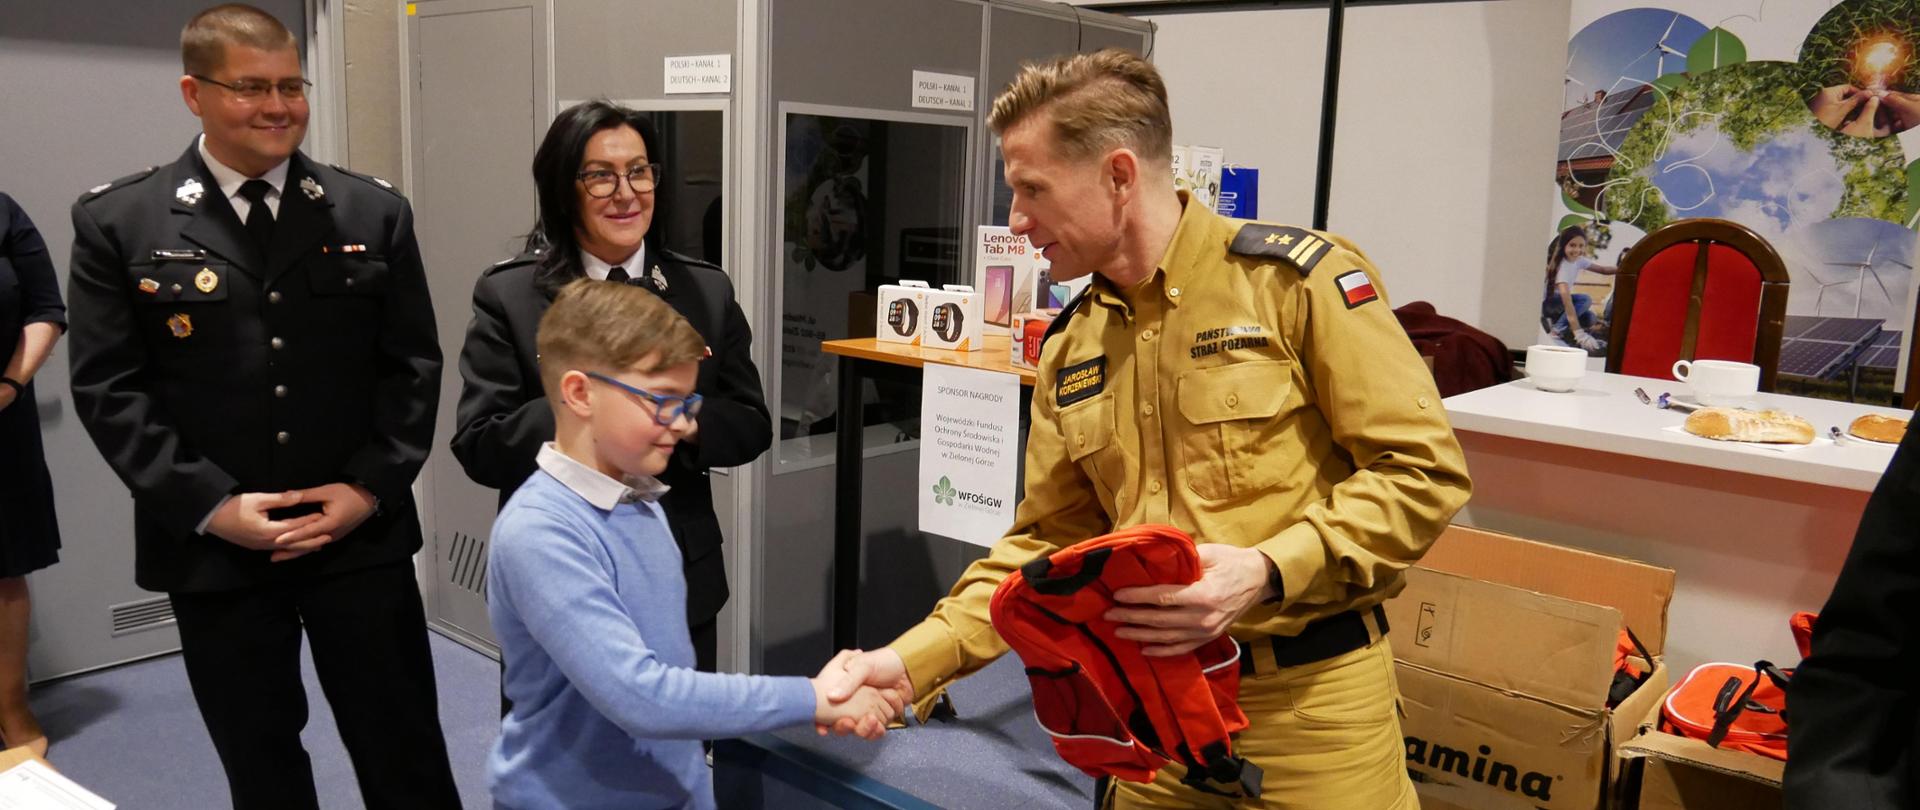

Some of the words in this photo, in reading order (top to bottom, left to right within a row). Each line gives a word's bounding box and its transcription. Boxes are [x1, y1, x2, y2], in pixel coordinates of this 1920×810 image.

[670, 60, 690, 69] POLSKI
[670, 75, 697, 84] DEUTSCH
[722, 74, 728, 83] 2
[919, 81, 938, 90] POLSKI
[918, 95, 944, 105] DEUTSCH
[983, 233, 1027, 244] Lenovo
[983, 244, 1004, 254] Tab
[1007, 245, 1026, 256] M8
[1190, 342, 1218, 359] STRAŻ
[1221, 336, 1270, 352] POŻARNA
[1063, 365, 1100, 385] JAROSŁAW
[937, 385, 969, 398] SPONSOR
[969, 391, 1003, 403] NAGRODY
[1059, 374, 1102, 397] KORZENIEWSKI
[935, 413, 975, 427] Wojewódzki
[976, 420, 1003, 432] Fundusz
[934, 425, 962, 437] Ochrony
[963, 428, 1000, 444] Środowiska
[936, 438, 973, 451] Gospodarki
[974, 444, 1000, 458] Wodnej
[949, 451, 974, 465] Zielonej
[975, 456, 995, 467] Górze
[958, 490, 1002, 508] WFOŚiGW
